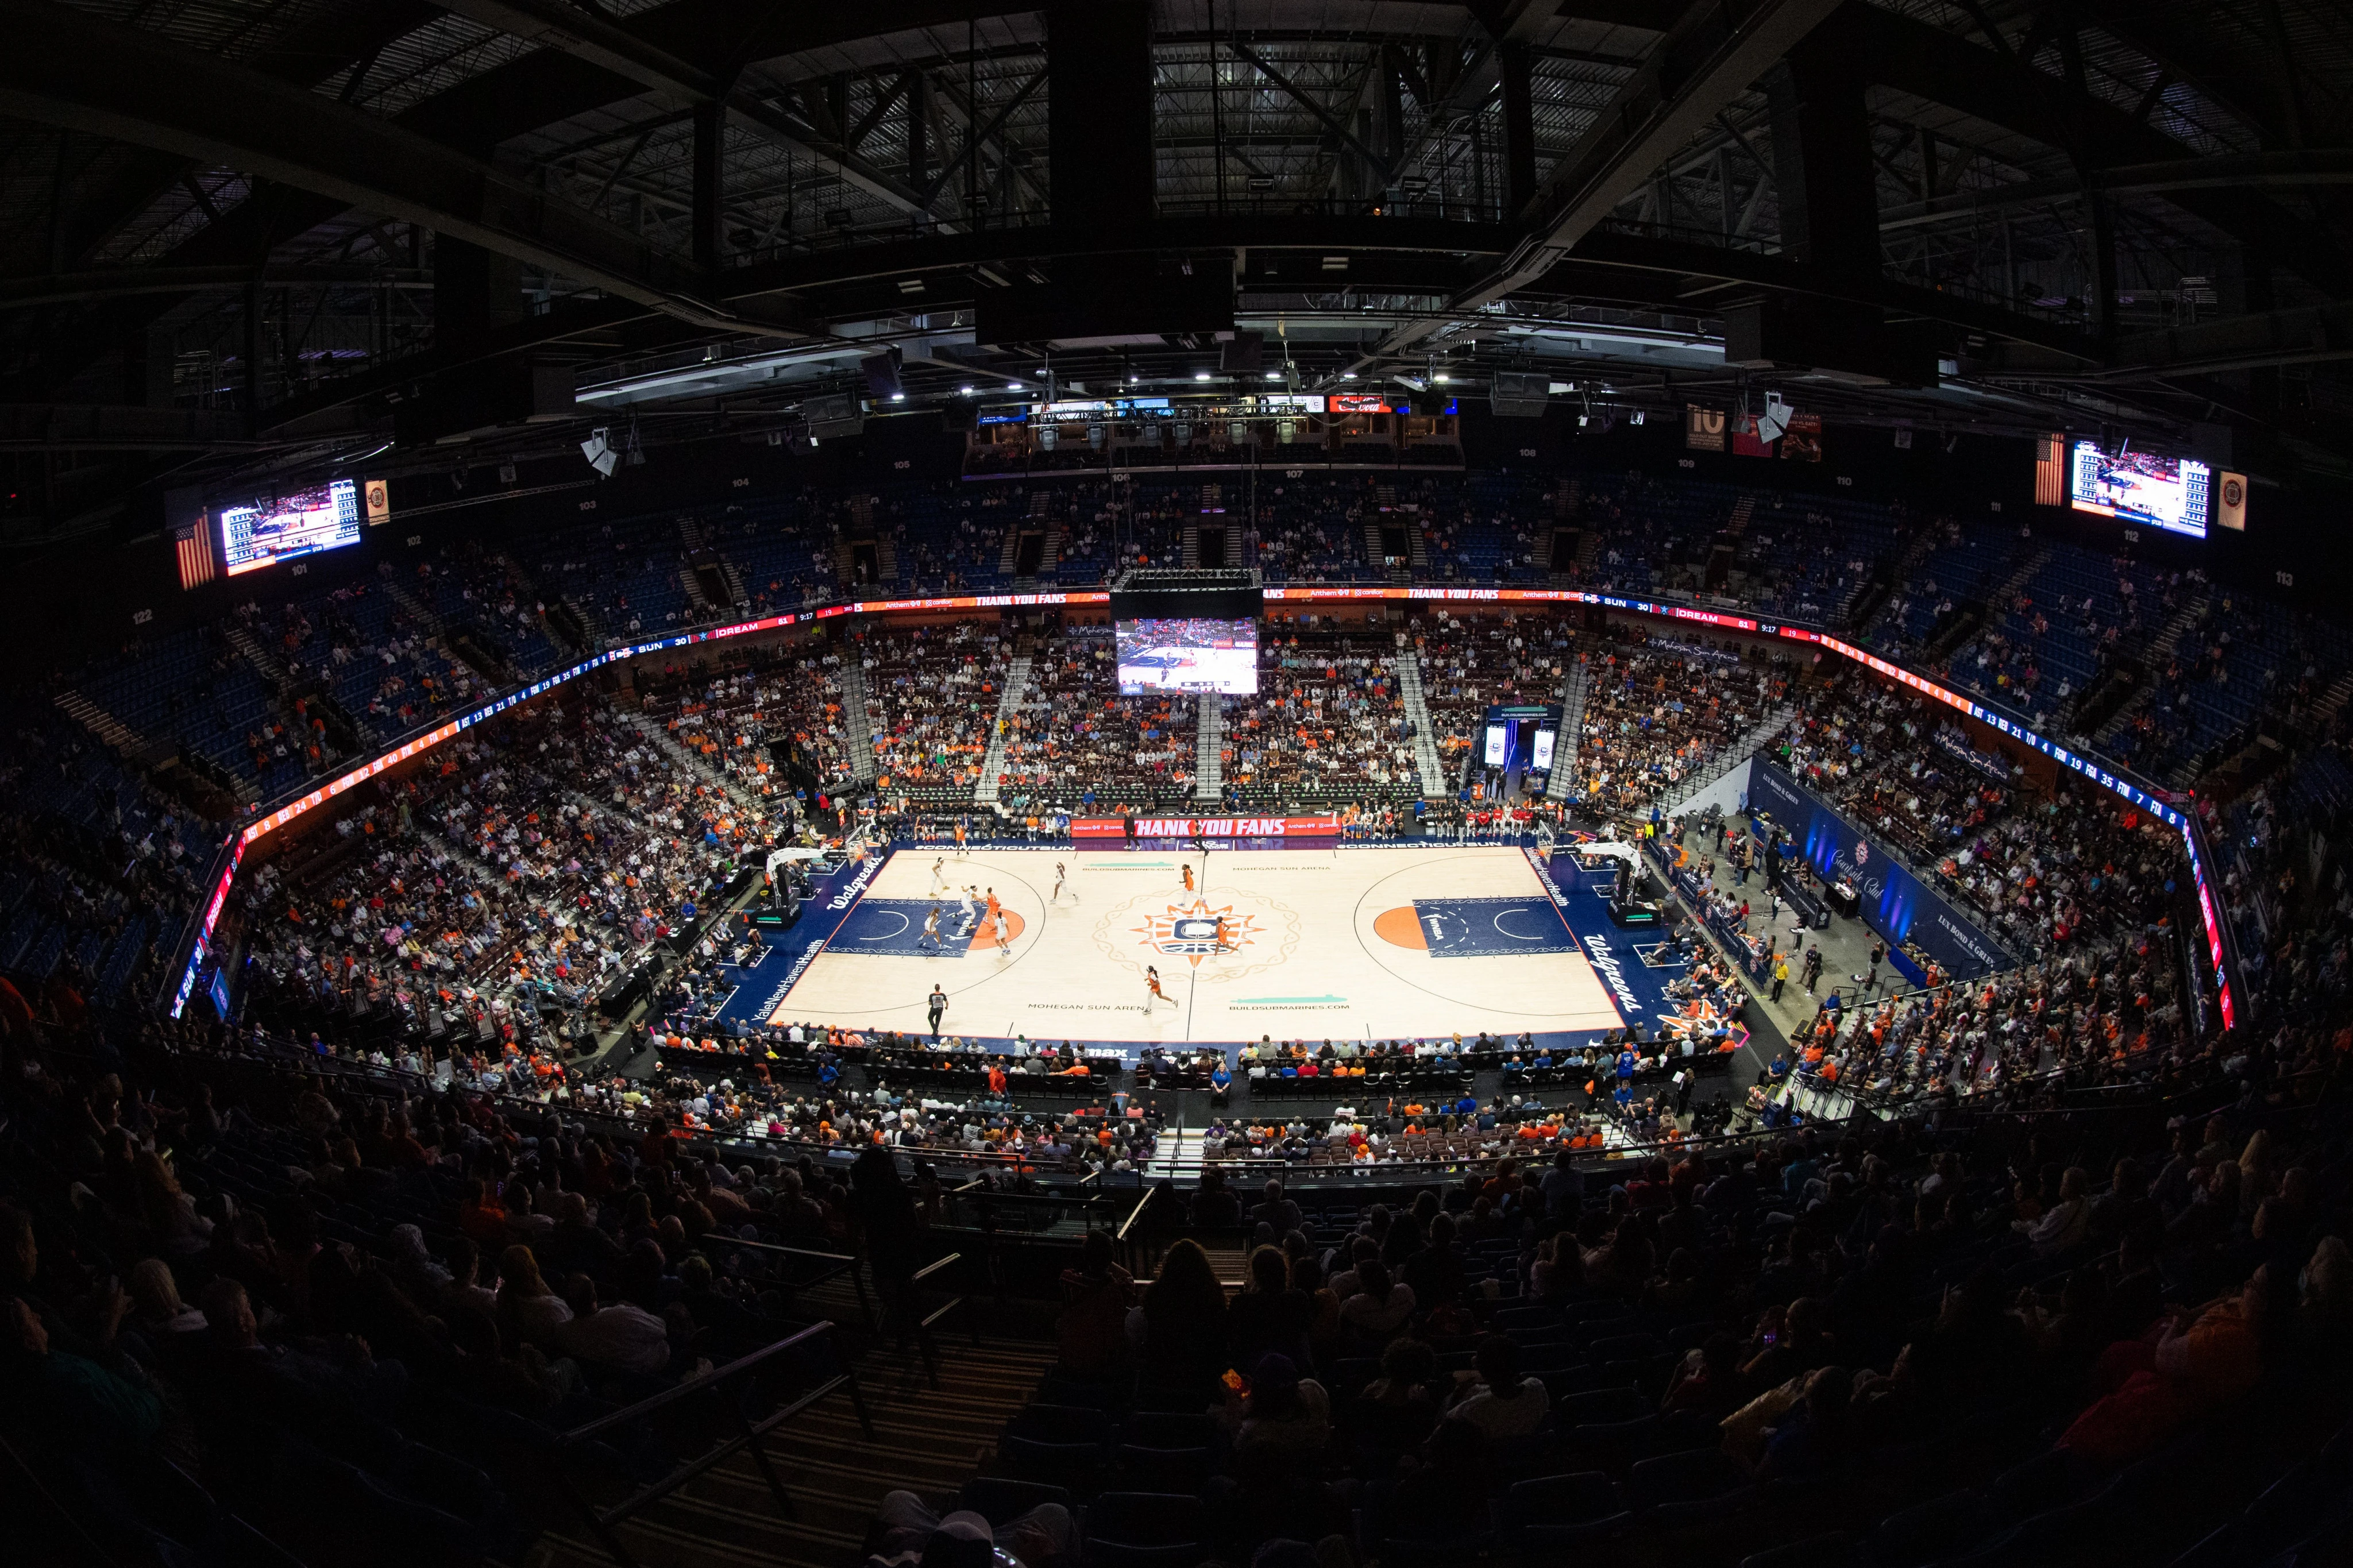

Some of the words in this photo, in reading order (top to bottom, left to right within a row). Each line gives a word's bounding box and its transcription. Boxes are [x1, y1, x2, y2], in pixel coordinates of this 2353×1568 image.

[1519, 449, 1536, 457] 108
[894, 461, 910, 469] 105
[1678, 459, 1695, 468] 109
[1286, 470, 1303, 478] 107
[1837, 476, 1852, 485] 110
[732, 478, 749, 487] 104
[579, 500, 596, 510] 103
[1991, 501, 2001, 512] 111
[407, 535, 422, 547] 102
[2124, 530, 2139, 542] 112
[292, 563, 307, 576] 101
[2276, 570, 2293, 586] 113
[976, 595, 1012, 606] THANK
[1014, 595, 1036, 605] YOU
[1037, 593, 1066, 604] FANS
[1263, 589, 1284, 598] ANS
[1409, 589, 1445, 598] THANK
[1446, 589, 1469, 598] YOU
[1471, 590, 1499, 599] FANS
[133, 609, 153, 624] 122
[1604, 598, 1626, 607] SUN
[1679, 609, 1718, 623] DREAM
[1738, 620, 1749, 628] 51
[1762, 624, 1776, 633] 9:17
[638, 642, 662, 654] SUN
[674, 638, 686, 646] 30
[719, 623, 758, 637] DREAM
[800, 612, 813, 621] 9:17
[1079, 625, 1114, 635] Mohegan
[1657, 639, 1692, 654] Mohegan
[1694, 647, 1712, 656] Sun
[1847, 647, 1854, 657] 24
[1869, 658, 1873, 666] 6
[1888, 666, 1896, 676] 12
[1908, 676, 1917, 686] 40
[1934, 688, 1939, 697] 4
[1955, 698, 1961, 708] 4
[461, 717, 470, 728] AST
[474, 711, 483, 722] 13
[484, 705, 493, 716] REB
[496, 701, 505, 711] 21
[521, 692, 526, 700] 4
[542, 681, 550, 690] 19
[552, 674, 561, 685] FGA
[562, 671, 571, 681] 35
[601, 655, 606, 663] 8
[1939, 735, 1968, 759] Mohegan
[1969, 751, 1982, 766] Sun
[1974, 705, 1983, 718] AST
[1986, 714, 1996, 725] 13
[1998, 718, 2008, 732] REB
[2011, 726, 2021, 739] 21
[2042, 742, 2048, 752] 4
[2070, 756, 2082, 770] 19
[2085, 763, 2097, 779] FGA
[2101, 773, 2113, 788] 35
[2116, 781, 2131, 798] FTM
[2137, 794, 2144, 804] 7
[2150, 800, 2162, 817] FTA
[2169, 812, 2176, 824] 8
[246, 828, 258, 841] AST
[264, 819, 271, 831] 8
[277, 809, 290, 824] REB
[295, 800, 307, 814] 24
[329, 786, 335, 795] 6
[359, 767, 370, 780] 12
[373, 759, 384, 773] FGA
[388, 753, 398, 764] 40
[419, 740, 424, 748] 4
[429, 732, 439, 744] FTA
[443, 728, 449, 737] 4
[1763, 774, 1771, 783] LUX
[1770, 779, 1781, 791] BOND
[1785, 791, 1799, 805] GREEN
[1135, 820, 1191, 836] THANK
[1198, 819, 1235, 835] YOU
[1236, 819, 1286, 835] FANS
[1831, 849, 1864, 883] Courtside
[1864, 876, 1885, 900] Club
[827, 856, 884, 910] Walgreens
[209, 891, 224, 928] DREAM
[1429, 918, 1444, 940] WNBA
[1938, 914, 1951, 929] LUX
[1950, 925, 1968, 944] BOND
[1968, 940, 1974, 949] &
[751, 940, 825, 1021] YaleNewHavenHealth
[1584, 934, 1642, 1013] Walgreens
